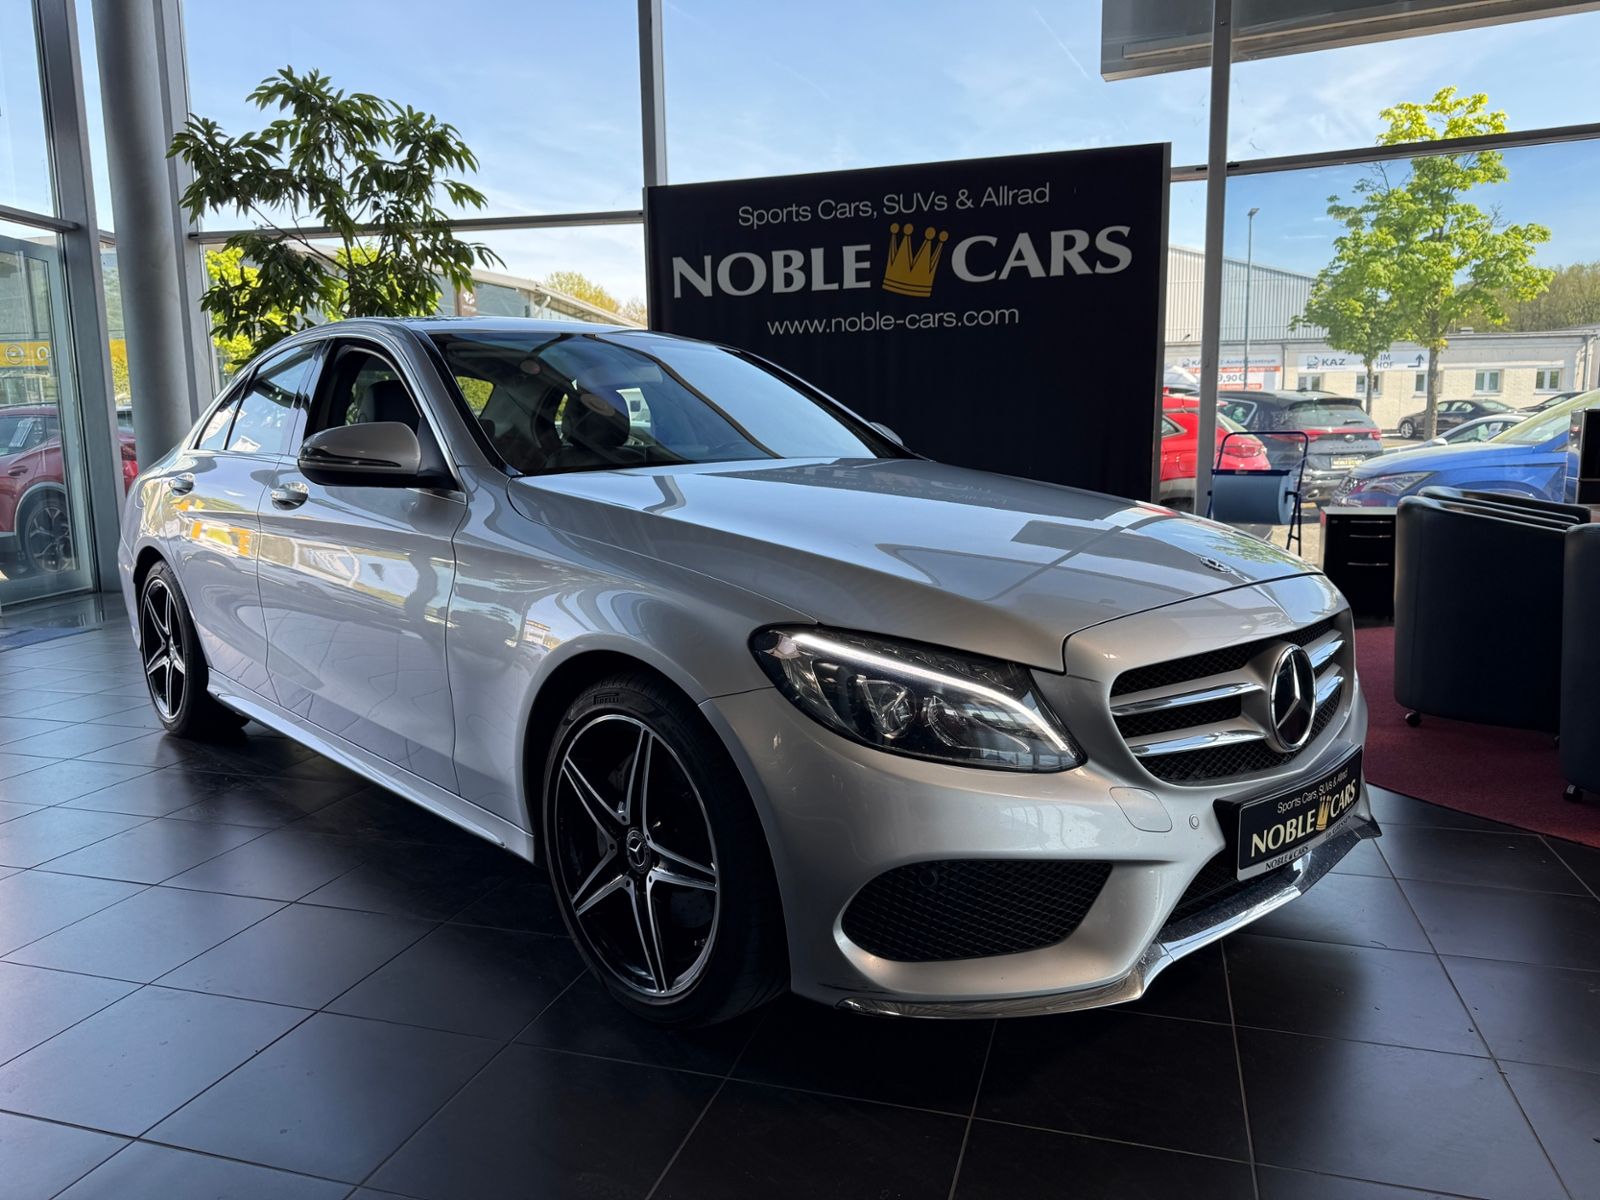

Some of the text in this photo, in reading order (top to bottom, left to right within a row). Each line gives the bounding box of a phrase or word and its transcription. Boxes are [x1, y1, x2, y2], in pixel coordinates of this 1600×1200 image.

[738, 182, 1050, 230] Sports Cars, SUVs & Allrad
[672, 225, 1132, 299] NOBLE CARS
[767, 306, 1019, 336] www.noble-cars.com
[1321, 358, 1346, 366] KAZ
[1380, 353, 1391, 361] IM
[593, 692, 620, 705] PIRELLI
[1277, 799, 1301, 815] Sports
[1302, 790, 1319, 804] Cars,
[1251, 808, 1316, 858] NOBLE
[1330, 778, 1356, 818] CARS
[1265, 854, 1290, 871] NOBLE
